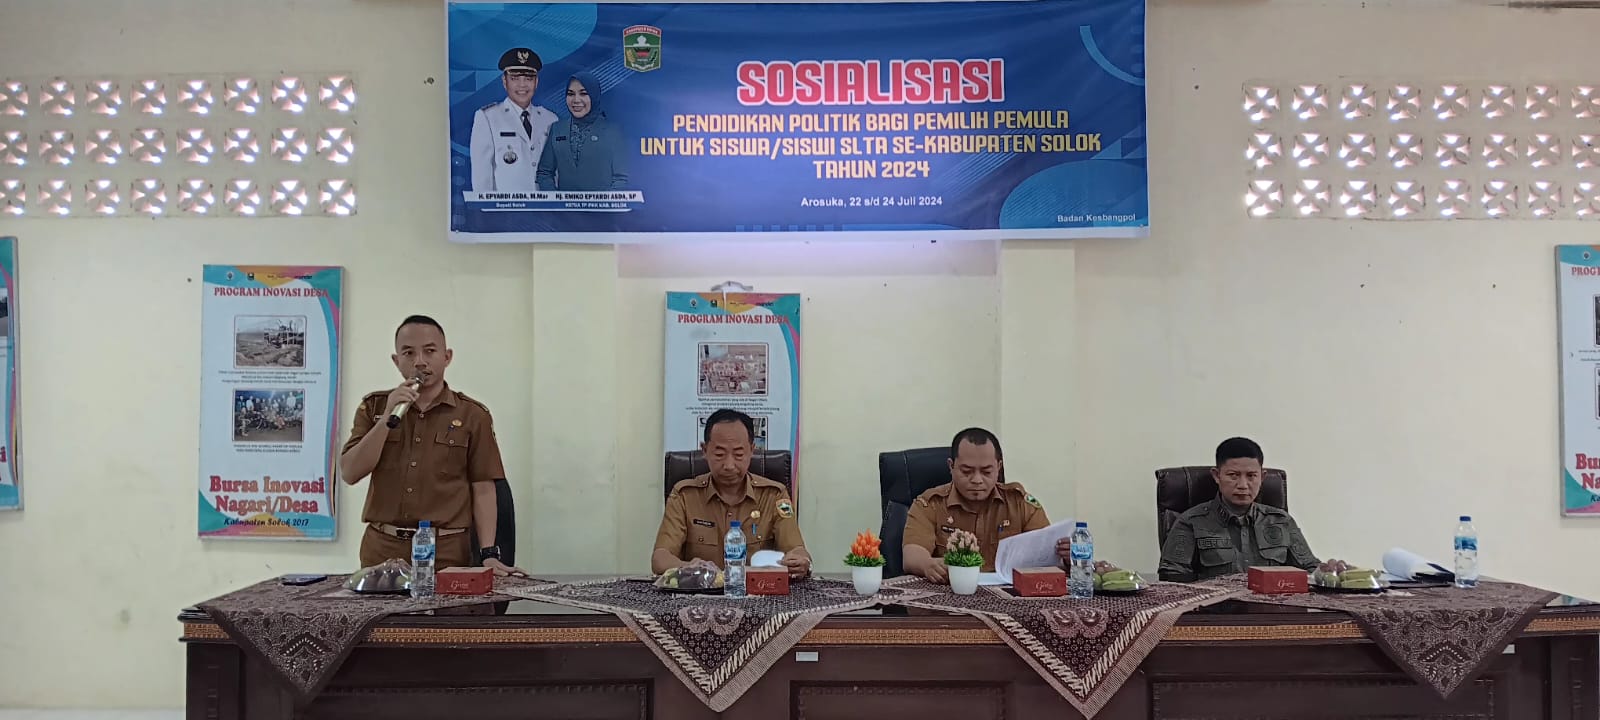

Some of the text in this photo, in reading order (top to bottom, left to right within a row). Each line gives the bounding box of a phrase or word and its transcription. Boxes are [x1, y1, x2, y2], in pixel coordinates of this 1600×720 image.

[737, 58, 1005, 106] SOSIALISASI
[673, 110, 1069, 133] PENDIDIKAN POLITIK BAGI PEMILIH PEMULA
[640, 133, 1102, 160] UNTUK SISWA/SISWI SLTA SE-KABUPATEN SOLOK
[813, 160, 930, 179] TAHUN 2024
[800, 196, 943, 208] Arosuka, 22 s/d 24 Juli 2024
[1057, 213, 1136, 223] Badan Kesbangpol
[214, 287, 329, 297] PROGRAM INOVASI DESA
[677, 314, 723, 324] PROGRAM
[725, 314, 763, 324] INOVASI
[1575, 453, 1600, 470] Bu
[209, 475, 325, 493] Bursa Inovasi
[215, 495, 319, 516] Nagari/Desa
[223, 517, 265, 527] Kabupaten
[292, 518, 309, 526] 2017
